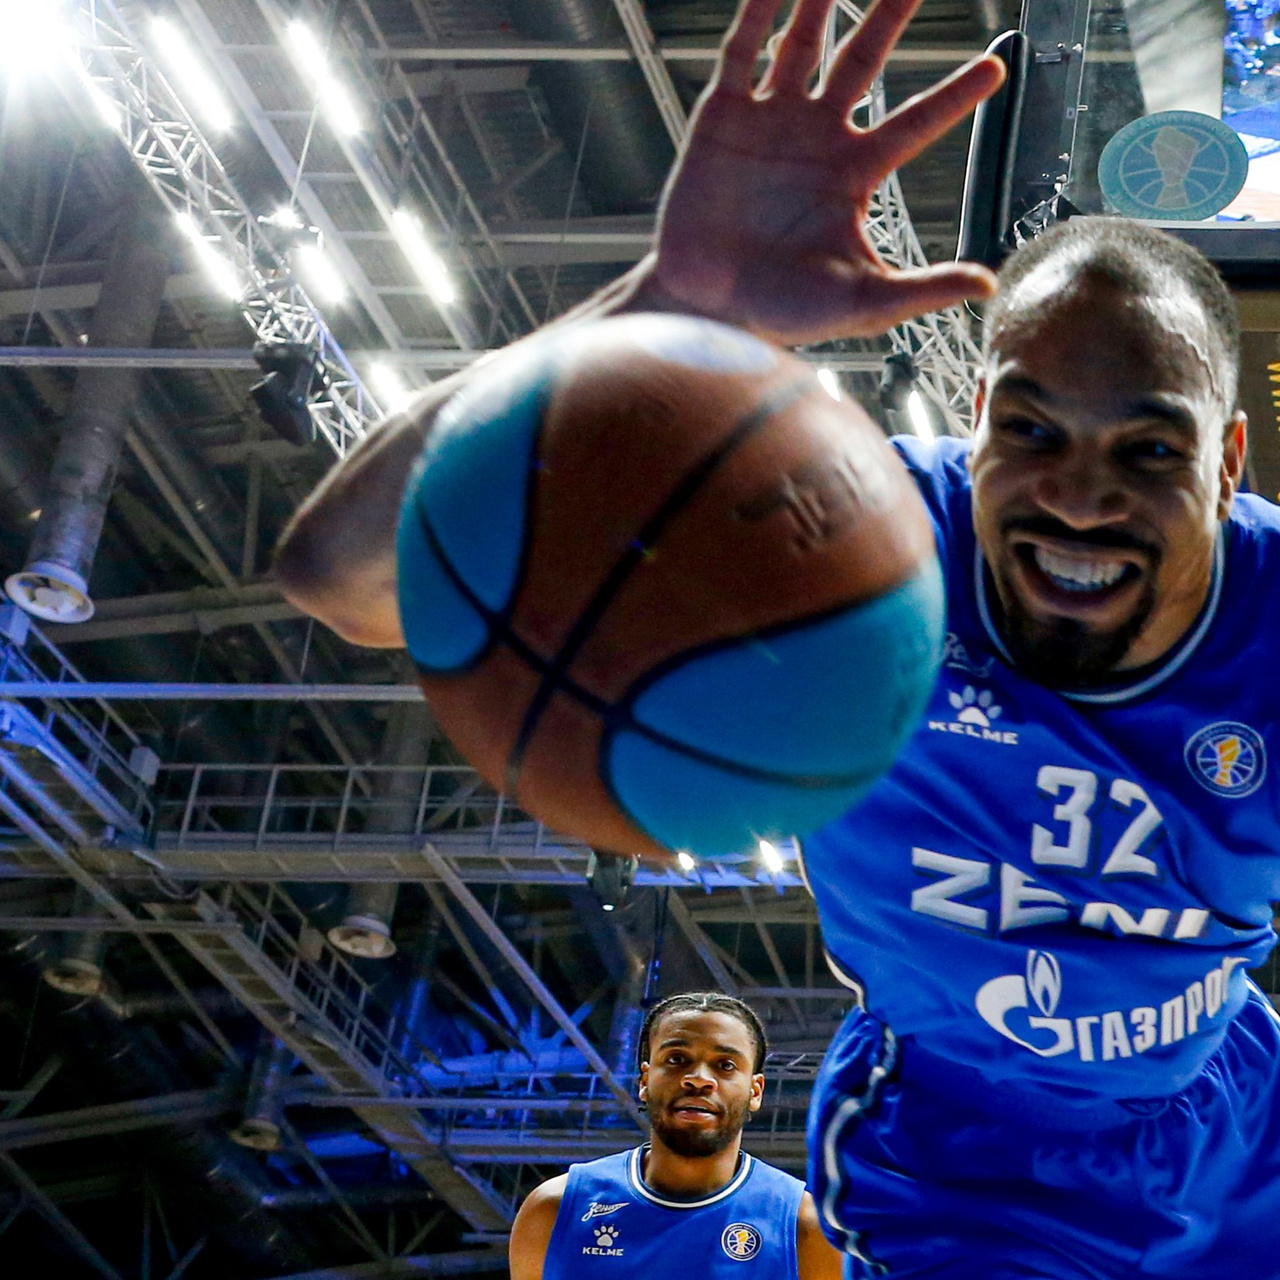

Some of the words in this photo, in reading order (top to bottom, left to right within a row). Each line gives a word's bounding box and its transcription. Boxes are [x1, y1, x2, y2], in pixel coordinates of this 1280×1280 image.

[928, 721, 1018, 745] KELME
[1031, 765, 1163, 877] 32
[582, 1246, 624, 1256] KELME
